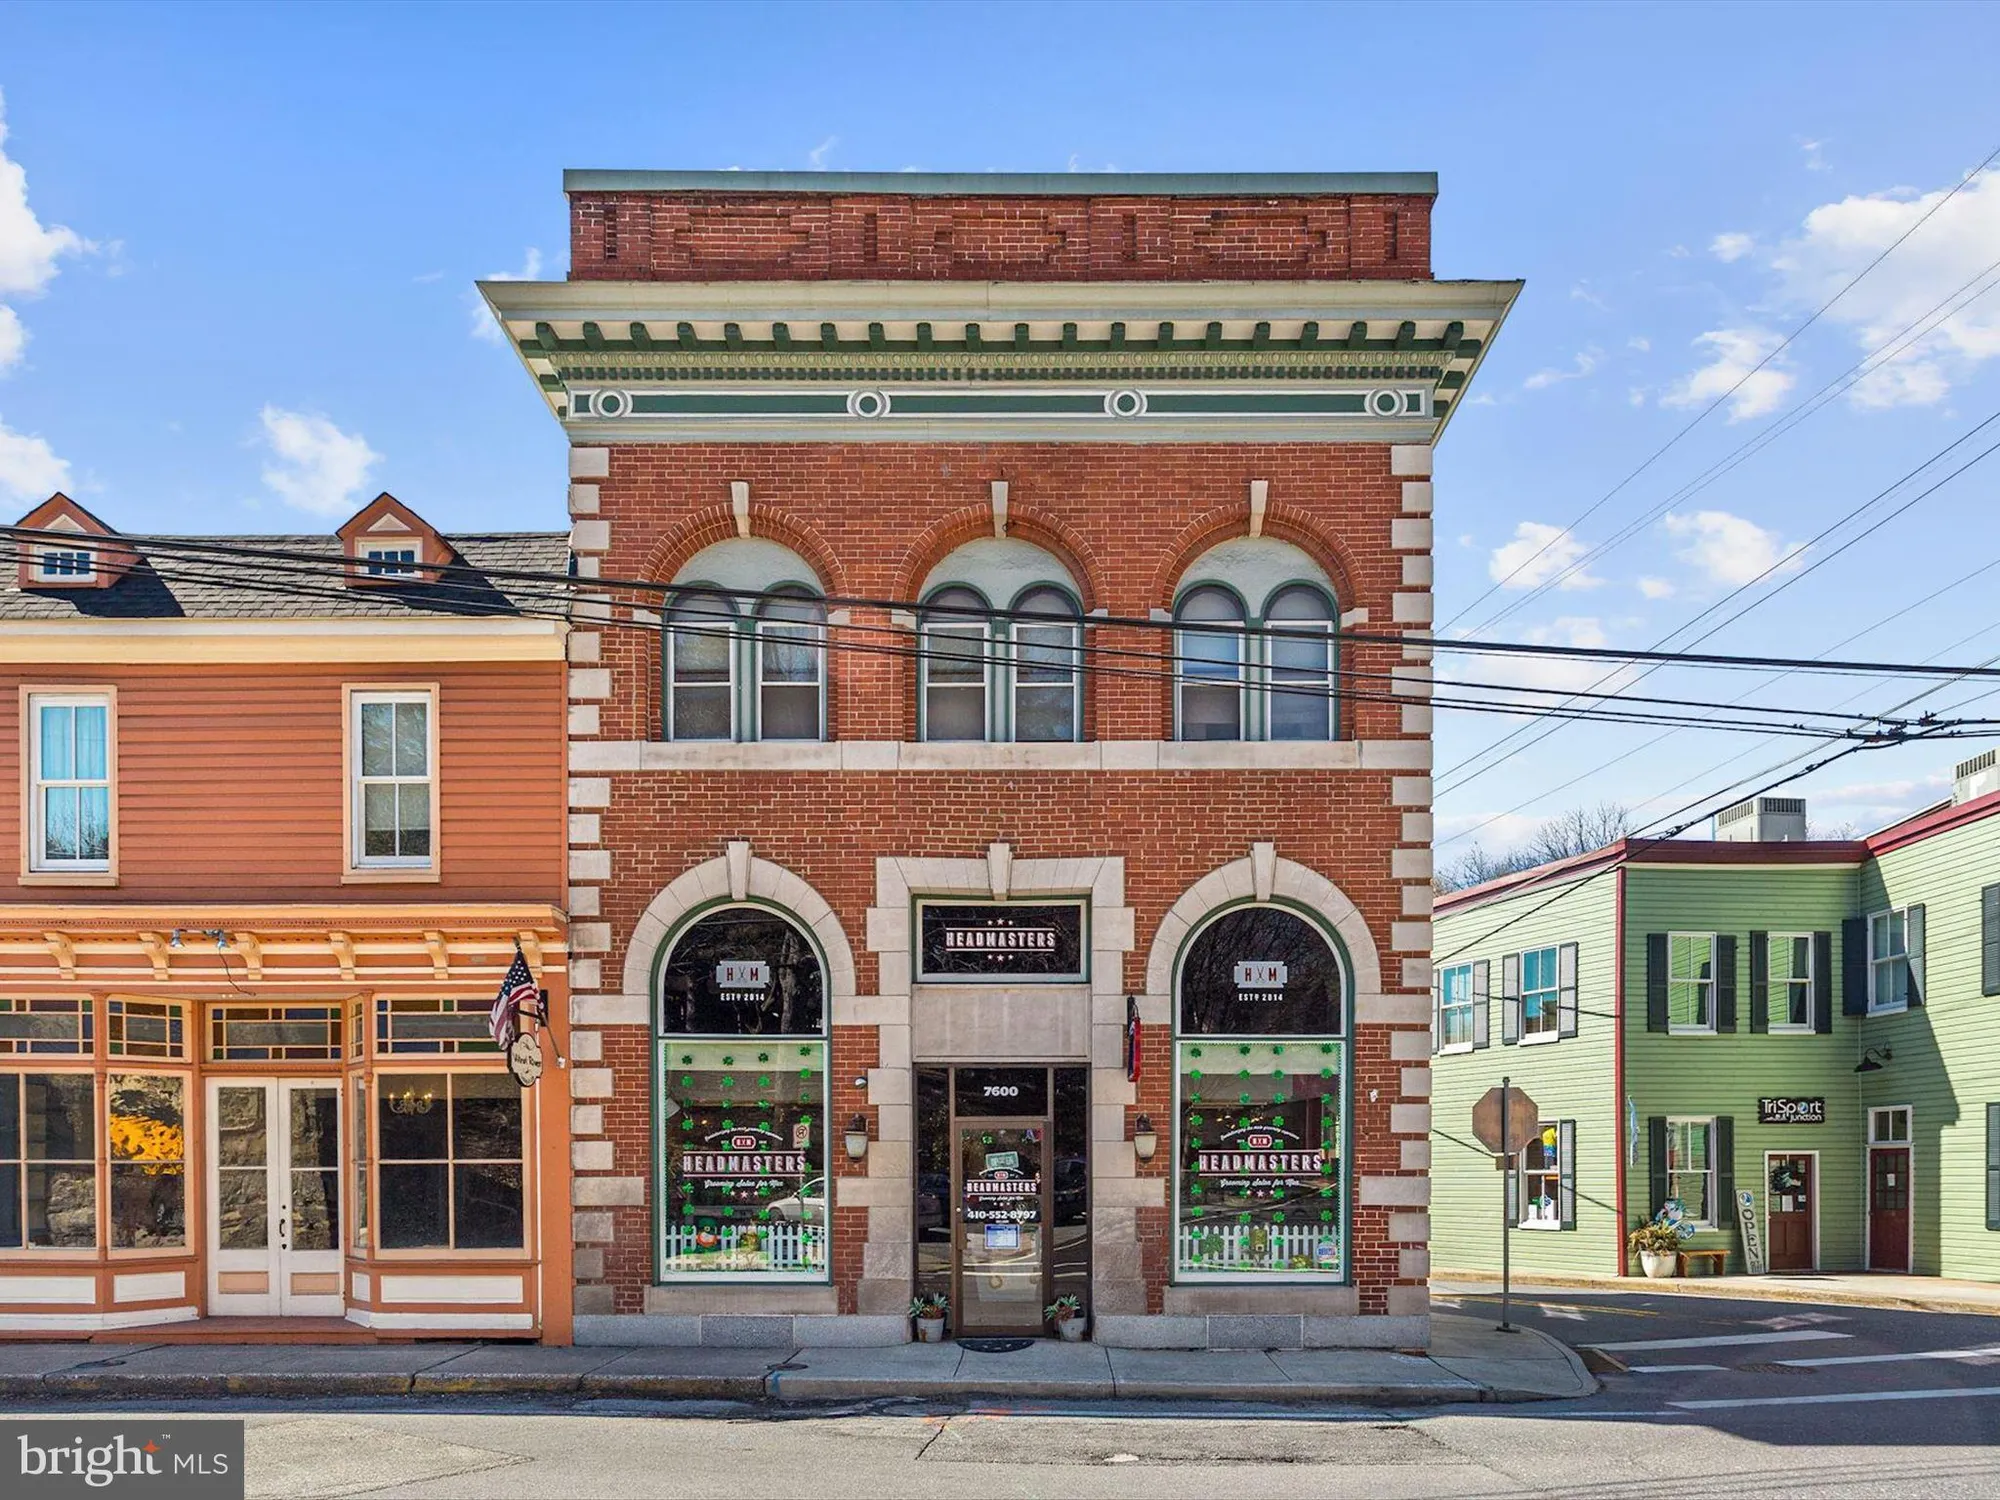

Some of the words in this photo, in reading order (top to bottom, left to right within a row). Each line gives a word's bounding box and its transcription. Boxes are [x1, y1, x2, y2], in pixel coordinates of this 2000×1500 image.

[945, 932, 1056, 947] HEADMASTERS
[744, 993, 765, 1001] 2014
[983, 1086, 1019, 1096] 7600
[683, 1155, 805, 1173] HEADMASTERS
[1199, 1154, 1322, 1172] HEADMASTERS
[966, 1182, 1037, 1192] HEADMASTERS
[967, 1210, 1036, 1219] 410-552-8797
[1742, 1208, 1759, 1260] OPEN
